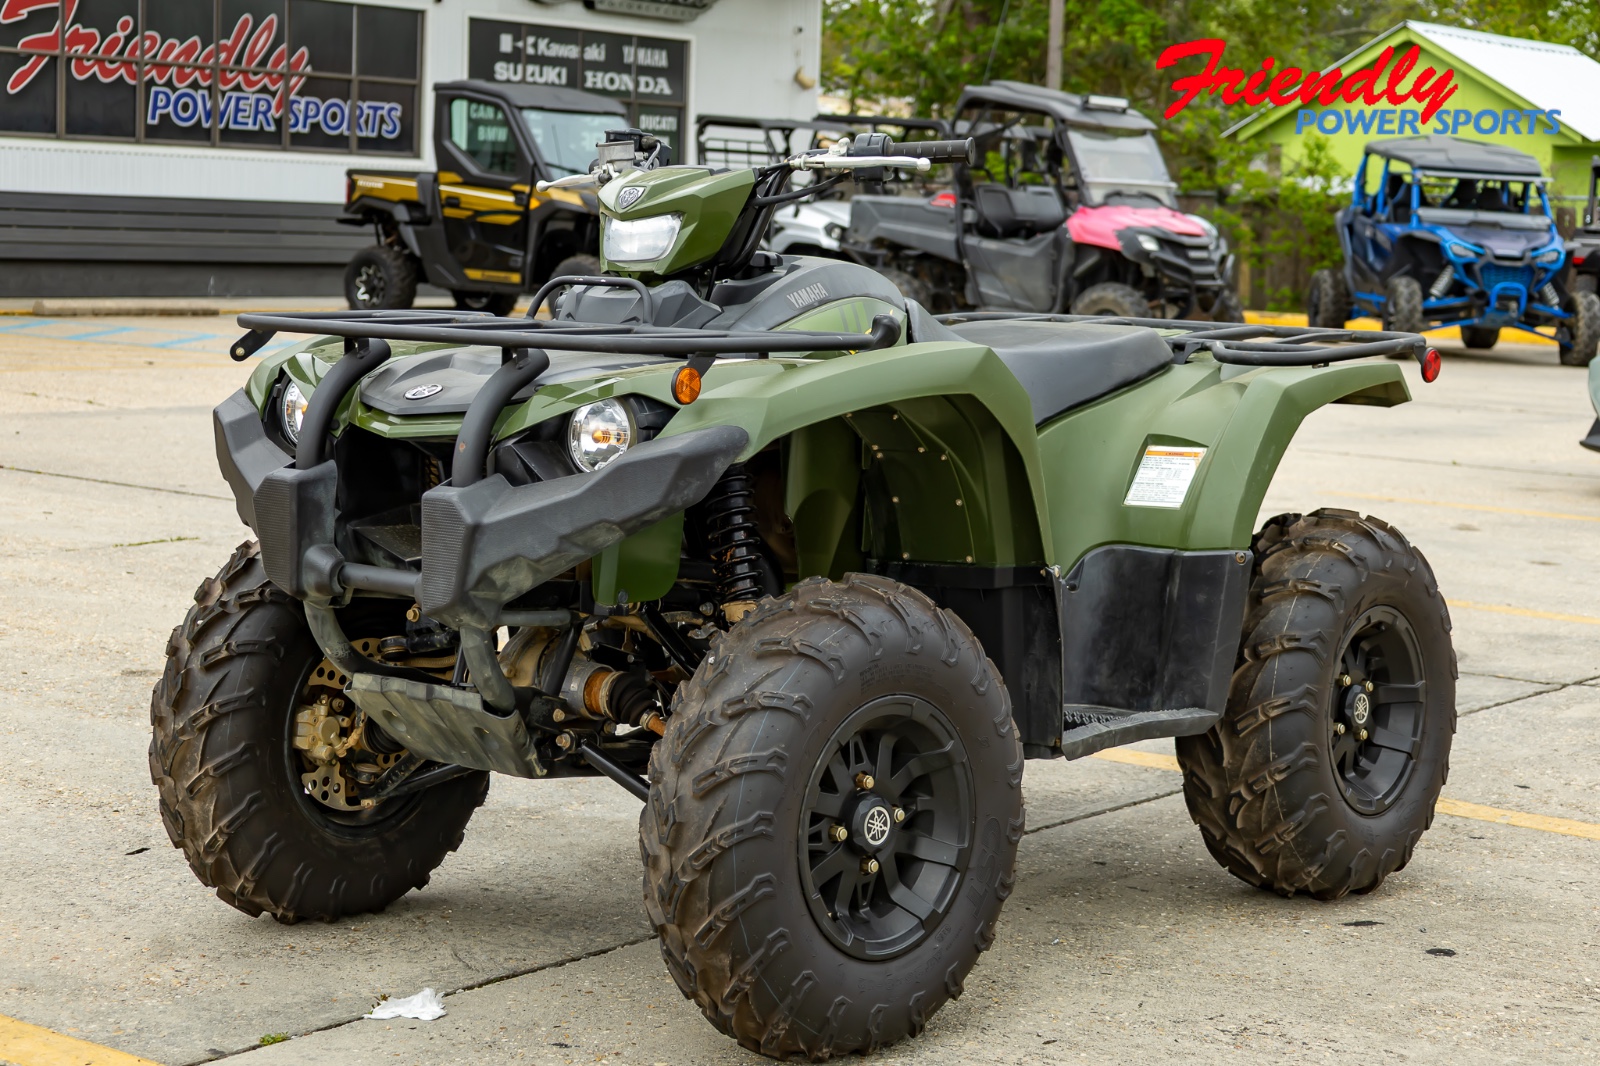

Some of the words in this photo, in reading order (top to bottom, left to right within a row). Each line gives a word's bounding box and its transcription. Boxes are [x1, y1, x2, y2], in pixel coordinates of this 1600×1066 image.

[0, 0, 312, 115] Friendly
[537, 37, 606, 62] Kawaaki
[493, 60, 568, 86] SUZUKI
[584, 70, 673, 95] HONDA
[147, 86, 277, 132] POWER
[288, 96, 402, 139] SPORTS
[786, 282, 829, 309] YAMAHA
